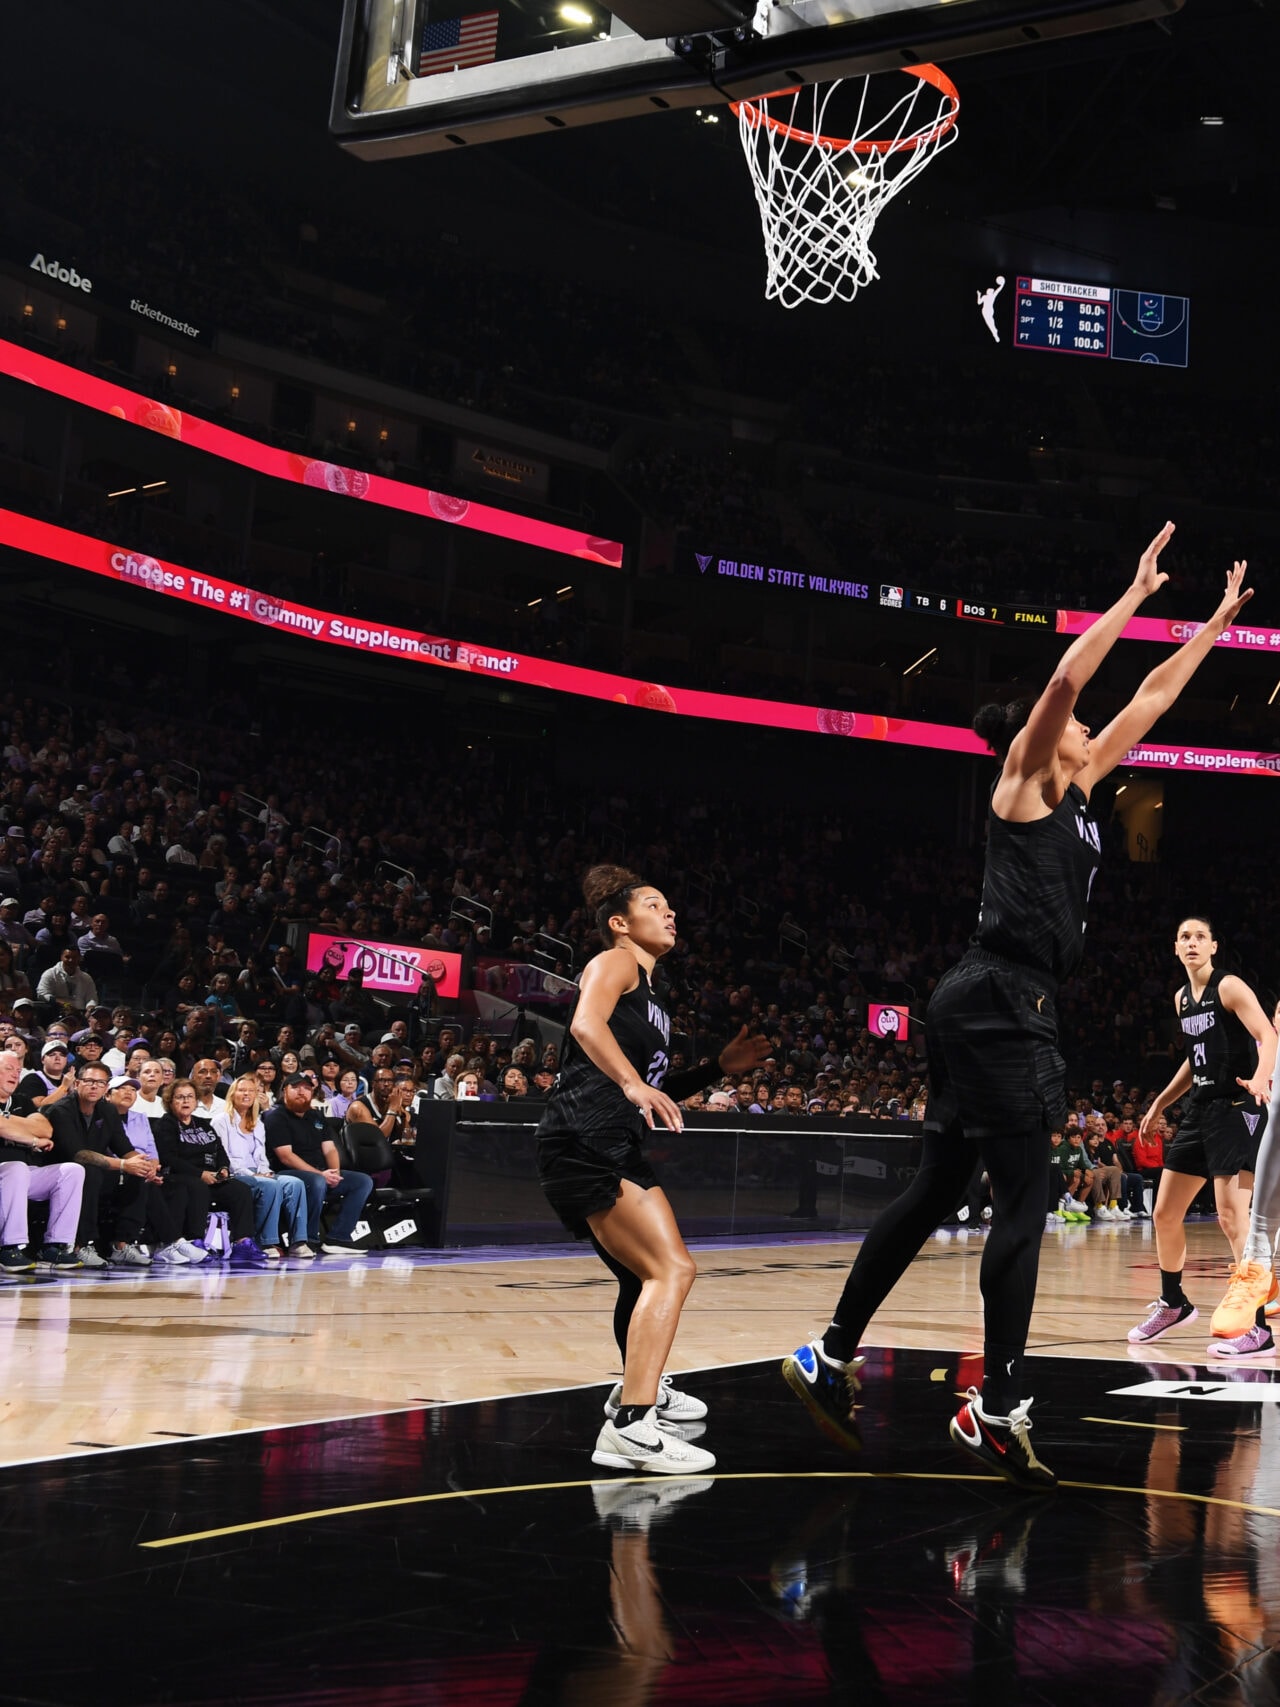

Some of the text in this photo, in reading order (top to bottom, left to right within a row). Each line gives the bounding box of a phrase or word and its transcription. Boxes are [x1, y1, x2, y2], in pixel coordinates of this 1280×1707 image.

[29, 253, 93, 294] Adobe
[1040, 282, 1099, 297] SHOT TRACKER
[1020, 299, 1032, 307] FG
[1047, 299, 1064, 312] 3/6
[129, 298, 200, 338] ticketmaster
[1020, 316, 1035, 324] 3PT
[1048, 317, 1063, 329] 1/2
[1047, 333, 1061, 345] 1/1
[718, 559, 869, 600] GOLDEN STATE VALKYRIES
[110, 552, 185, 591] Choose
[190, 576, 225, 603] The
[229, 590, 250, 611] #1
[255, 599, 325, 635] Gummy
[329, 620, 451, 660] Supplement
[879, 598, 903, 609] SCORES
[916, 595, 947, 611] TB 6
[963, 605, 998, 620] BOS 7
[1014, 612, 1049, 624] FINAL
[1171, 624, 1232, 642] Che
[1235, 630, 1265, 645] The
[357, 948, 416, 982] OLLY
[1193, 1042, 1207, 1067] 24
